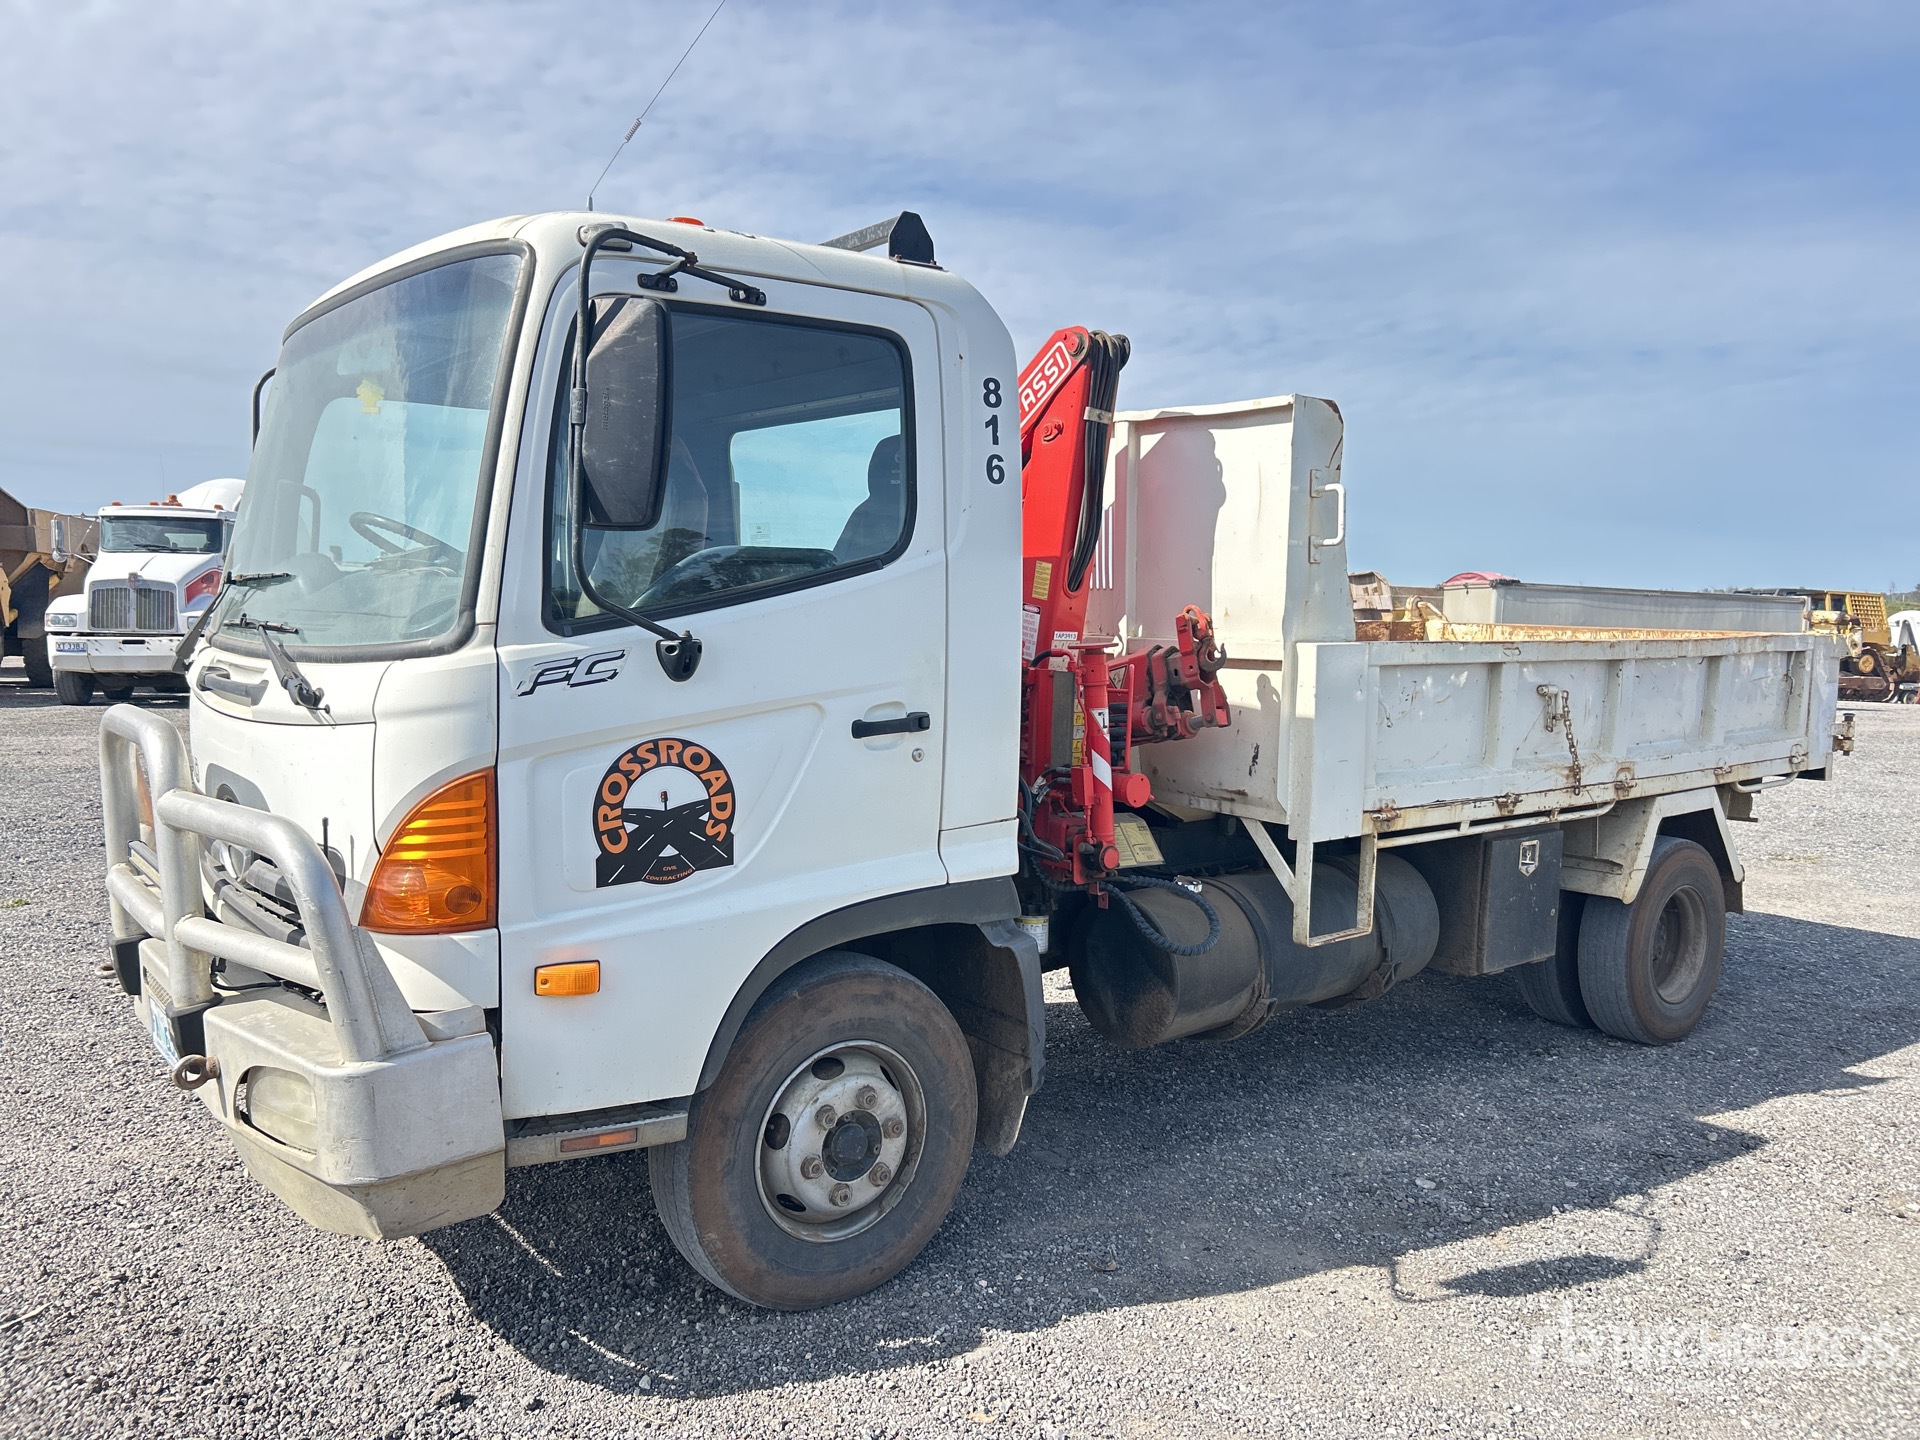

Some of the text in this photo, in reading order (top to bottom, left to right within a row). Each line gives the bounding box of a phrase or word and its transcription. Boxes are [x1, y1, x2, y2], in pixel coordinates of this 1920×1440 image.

[1019, 352, 1065, 412] ASSI
[517, 649, 626, 697] FC
[597, 739, 733, 855] CROSSROADS
[645, 868, 693, 881] CONTRACTING
